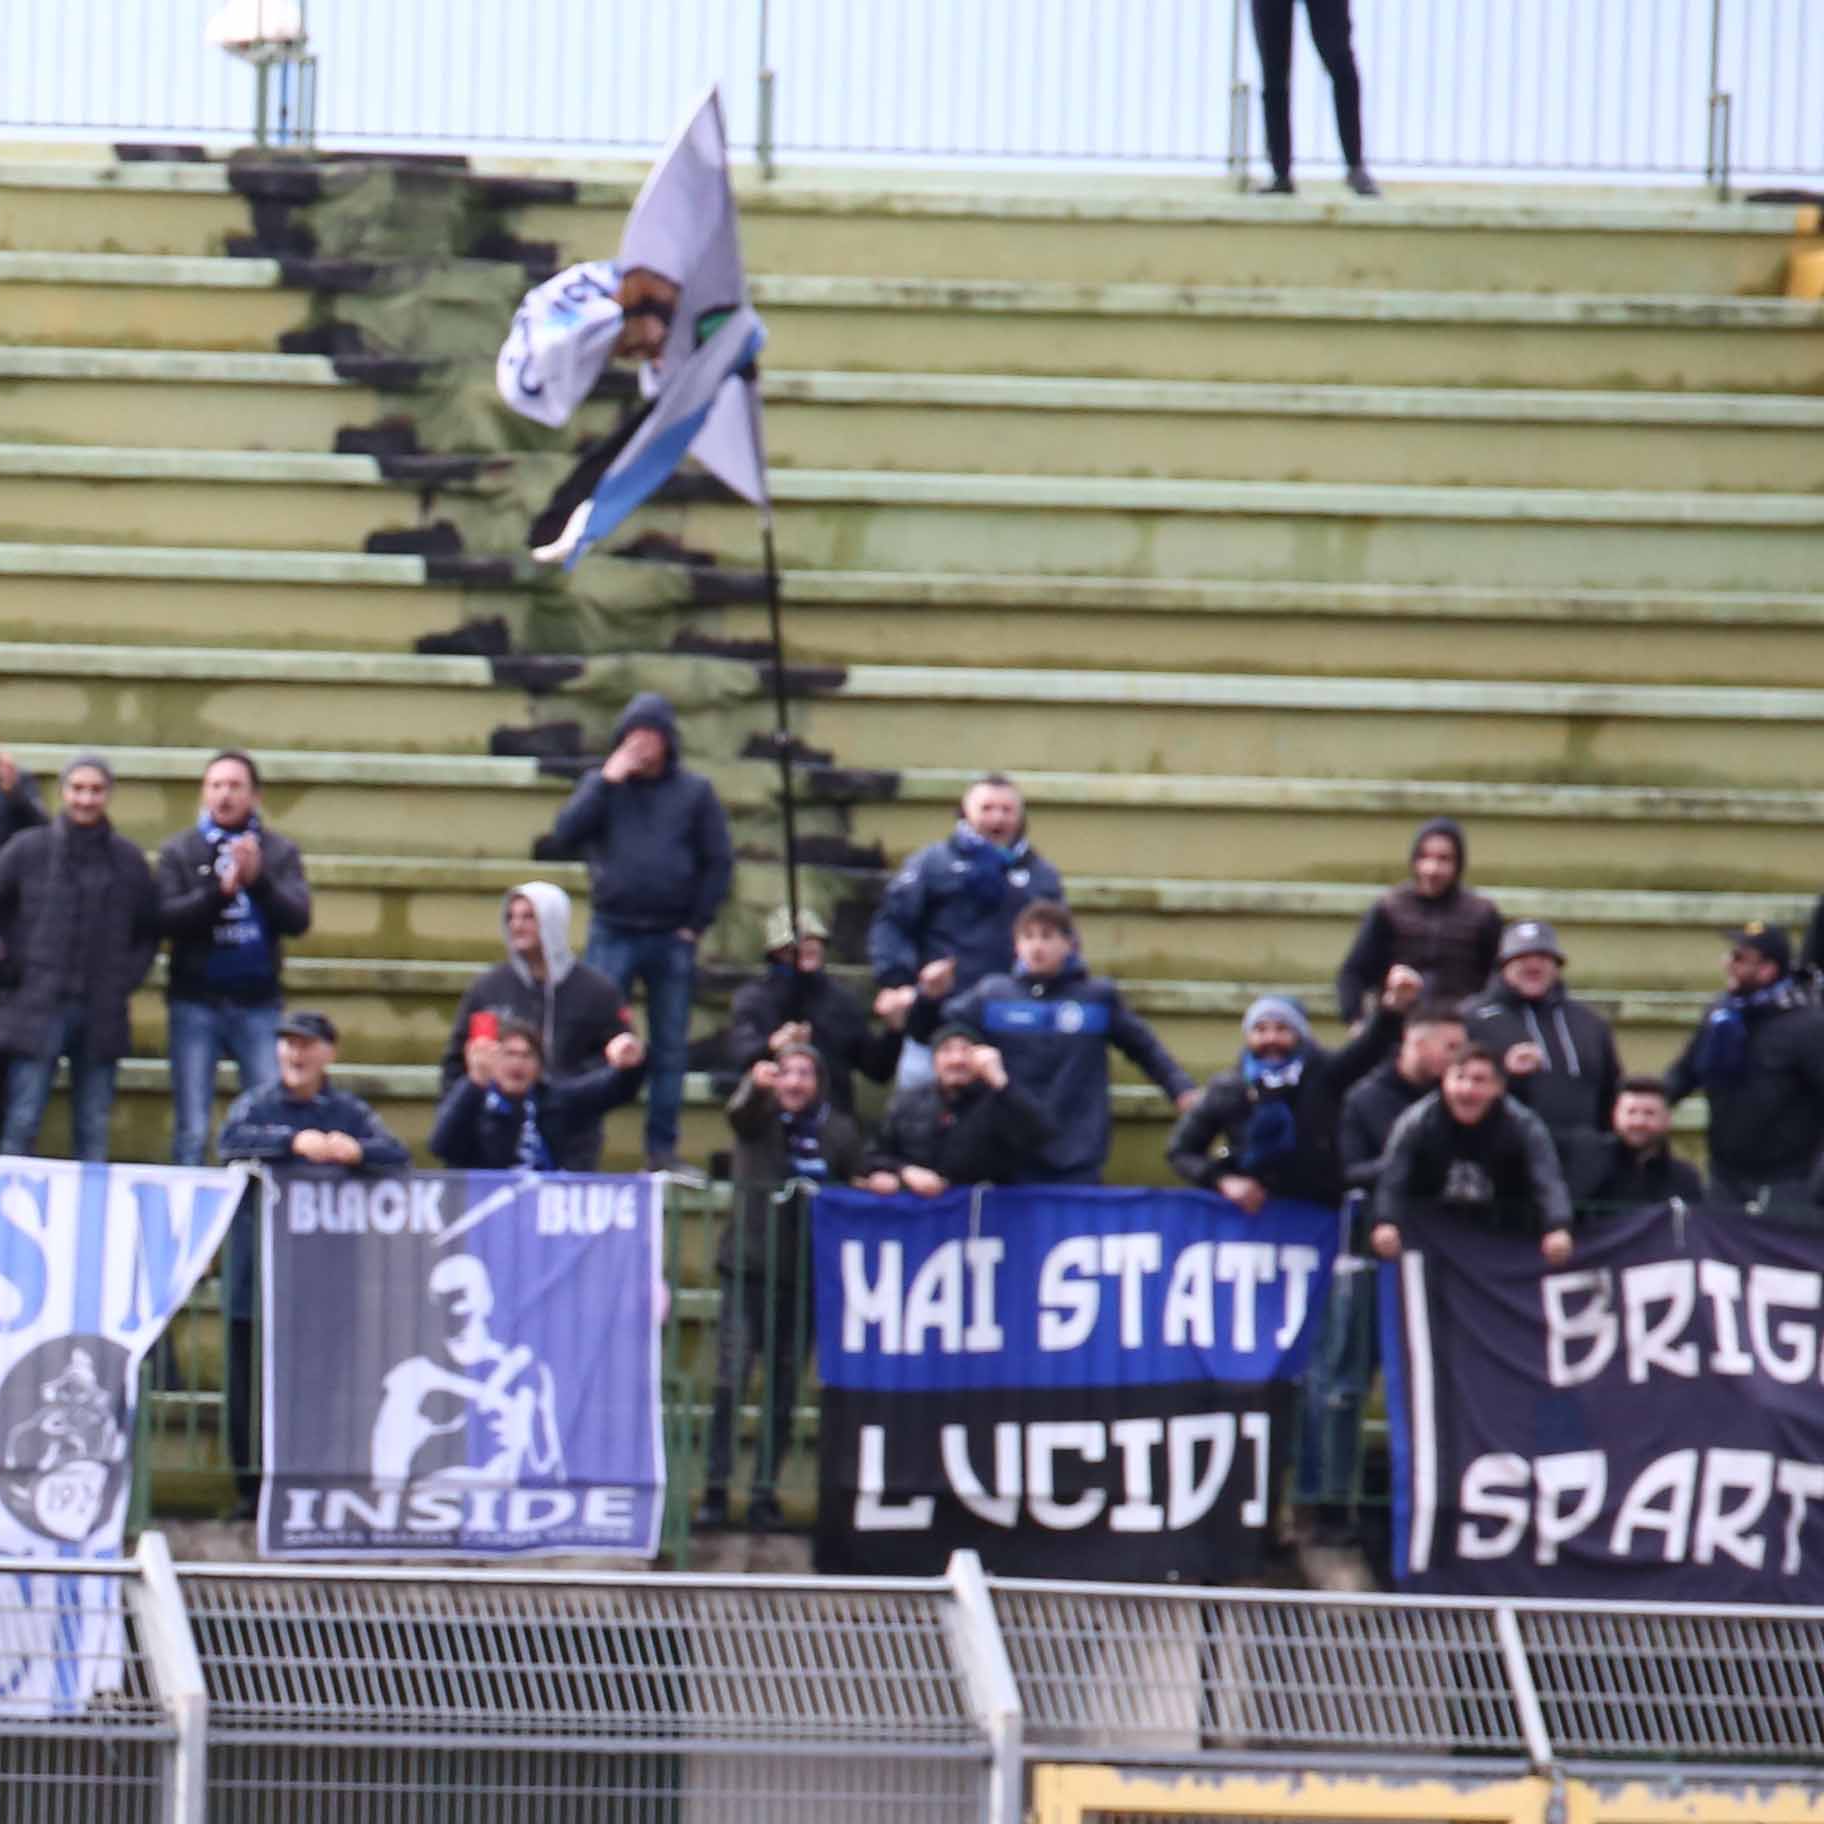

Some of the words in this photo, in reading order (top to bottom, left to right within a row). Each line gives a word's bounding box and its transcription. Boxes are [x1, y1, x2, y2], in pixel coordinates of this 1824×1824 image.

[288, 1180, 447, 1235] BLACK
[536, 1183, 636, 1235] BLUE
[841, 1236, 1005, 1354] MAI
[1038, 1231, 1320, 1353] STATI
[1541, 1259, 1824, 1387] BRIG
[283, 1486, 637, 1533] INSIDE
[853, 1411, 1270, 1532] LUCIDI
